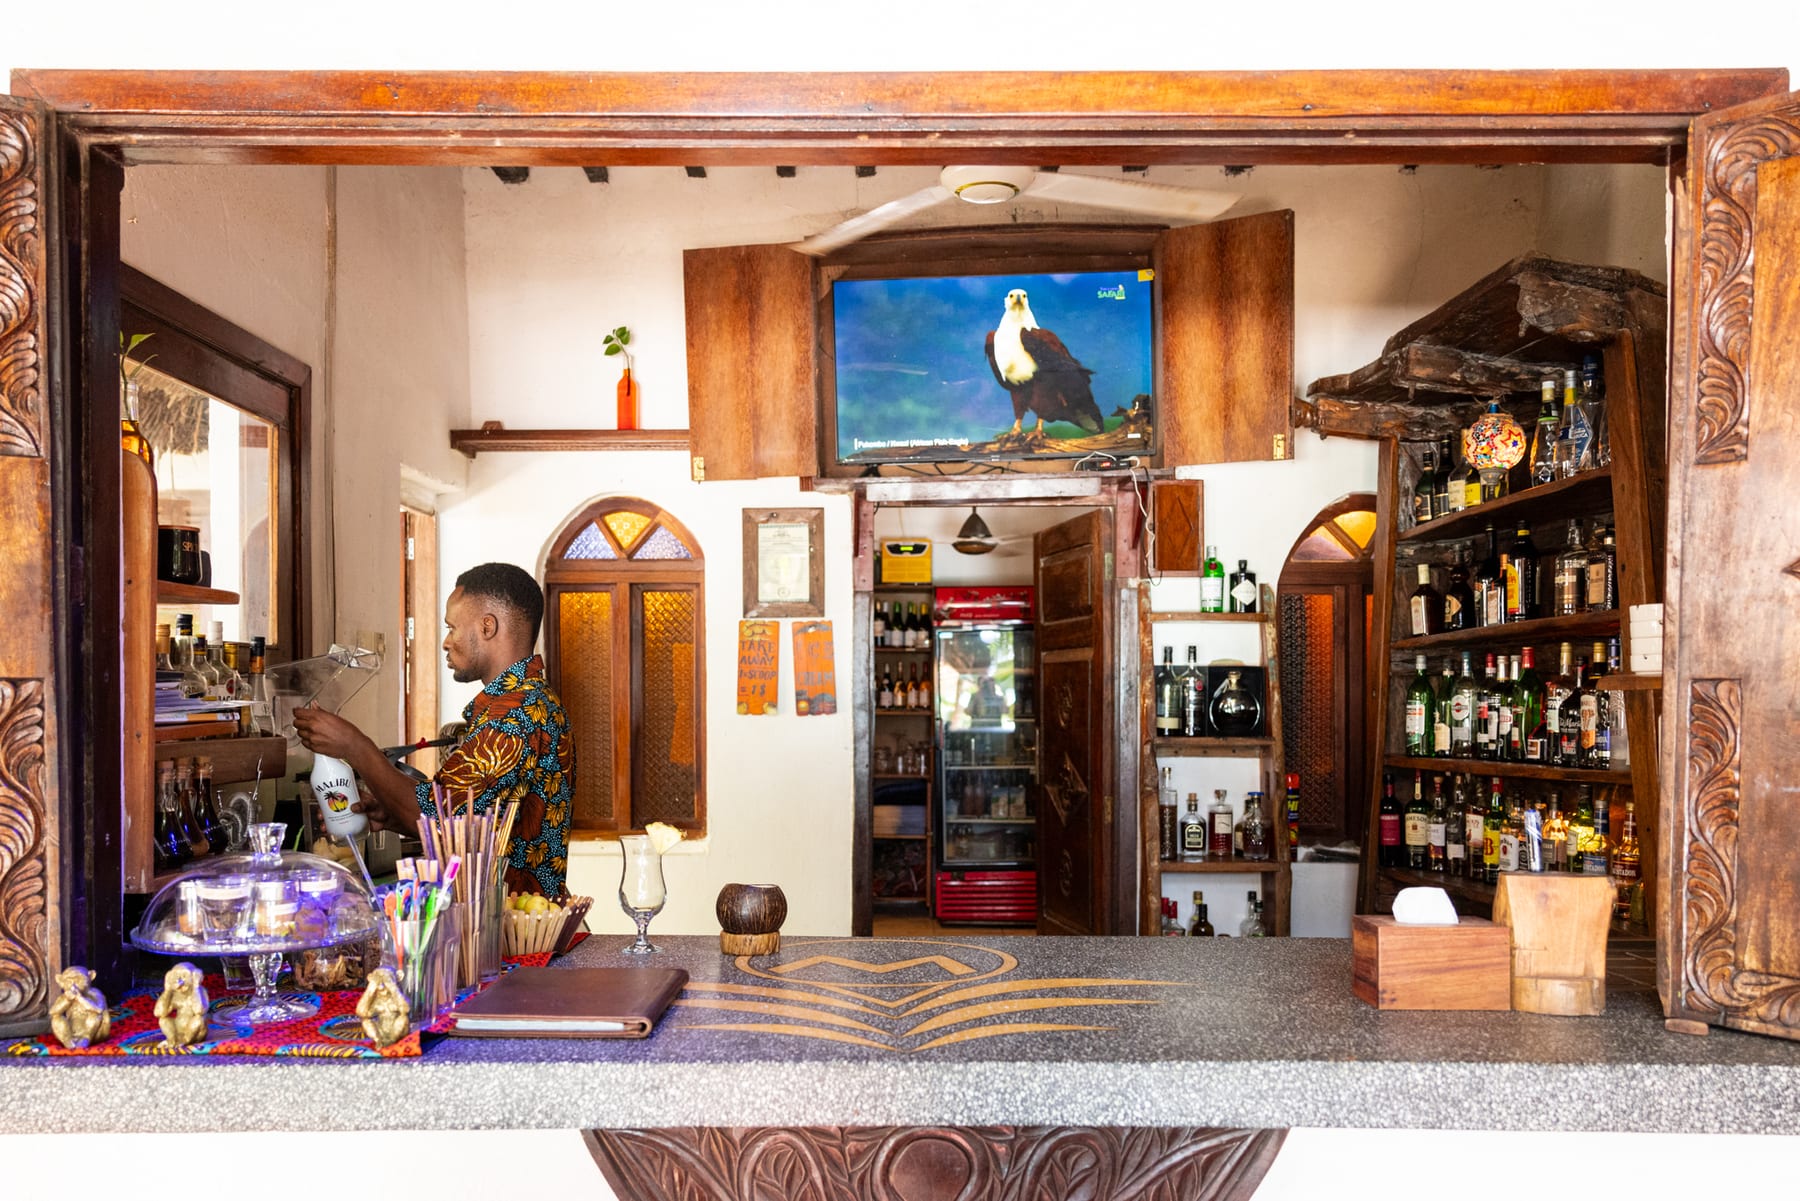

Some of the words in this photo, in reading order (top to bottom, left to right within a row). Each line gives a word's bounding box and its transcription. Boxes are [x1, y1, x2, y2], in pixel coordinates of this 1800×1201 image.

[740, 638, 776, 653] TAKE
[740, 655, 775, 666] AWAY
[315, 778, 351, 793] MALIBU
